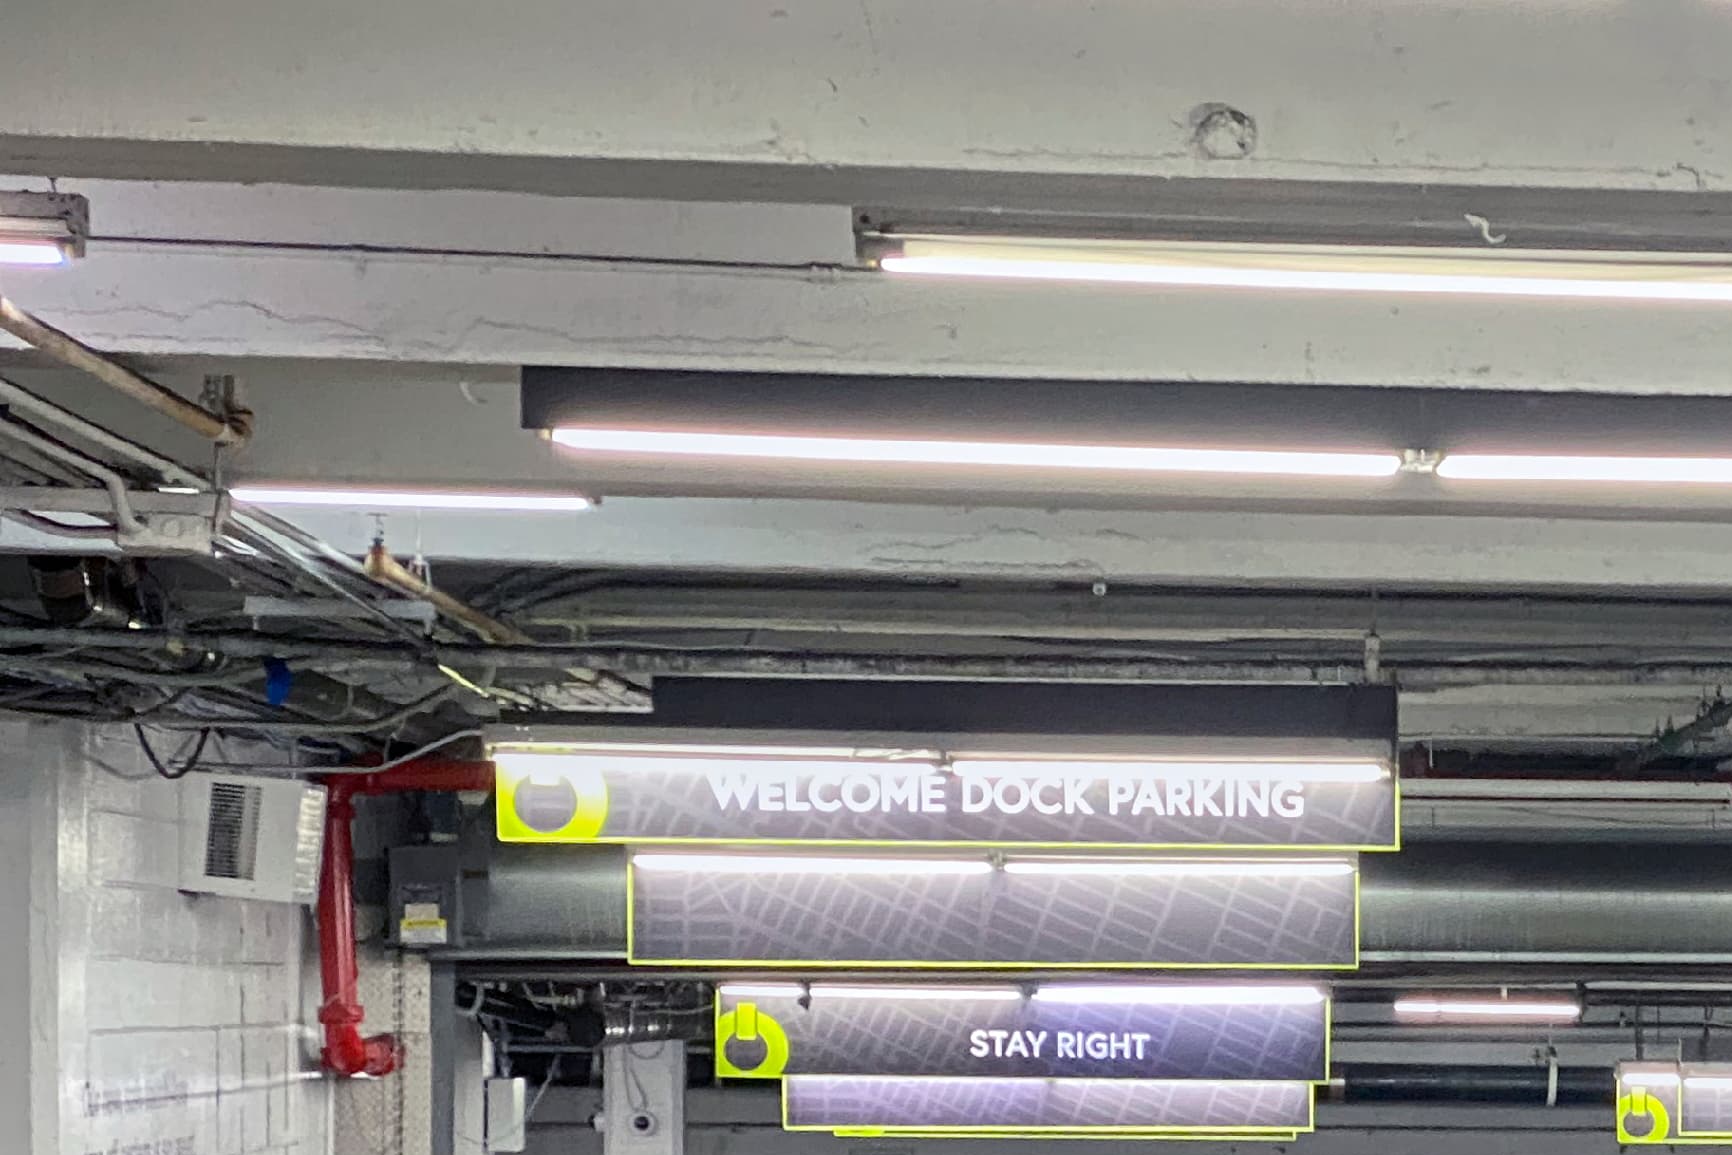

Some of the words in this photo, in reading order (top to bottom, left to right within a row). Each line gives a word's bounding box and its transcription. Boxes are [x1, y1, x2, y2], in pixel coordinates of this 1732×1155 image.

[706, 773, 947, 812] WELCOME
[961, 775, 1094, 815] DOCK
[1108, 777, 1305, 818] PARKING
[969, 1029, 1047, 1058] STAY
[1057, 1031, 1151, 1060] RIGHT
